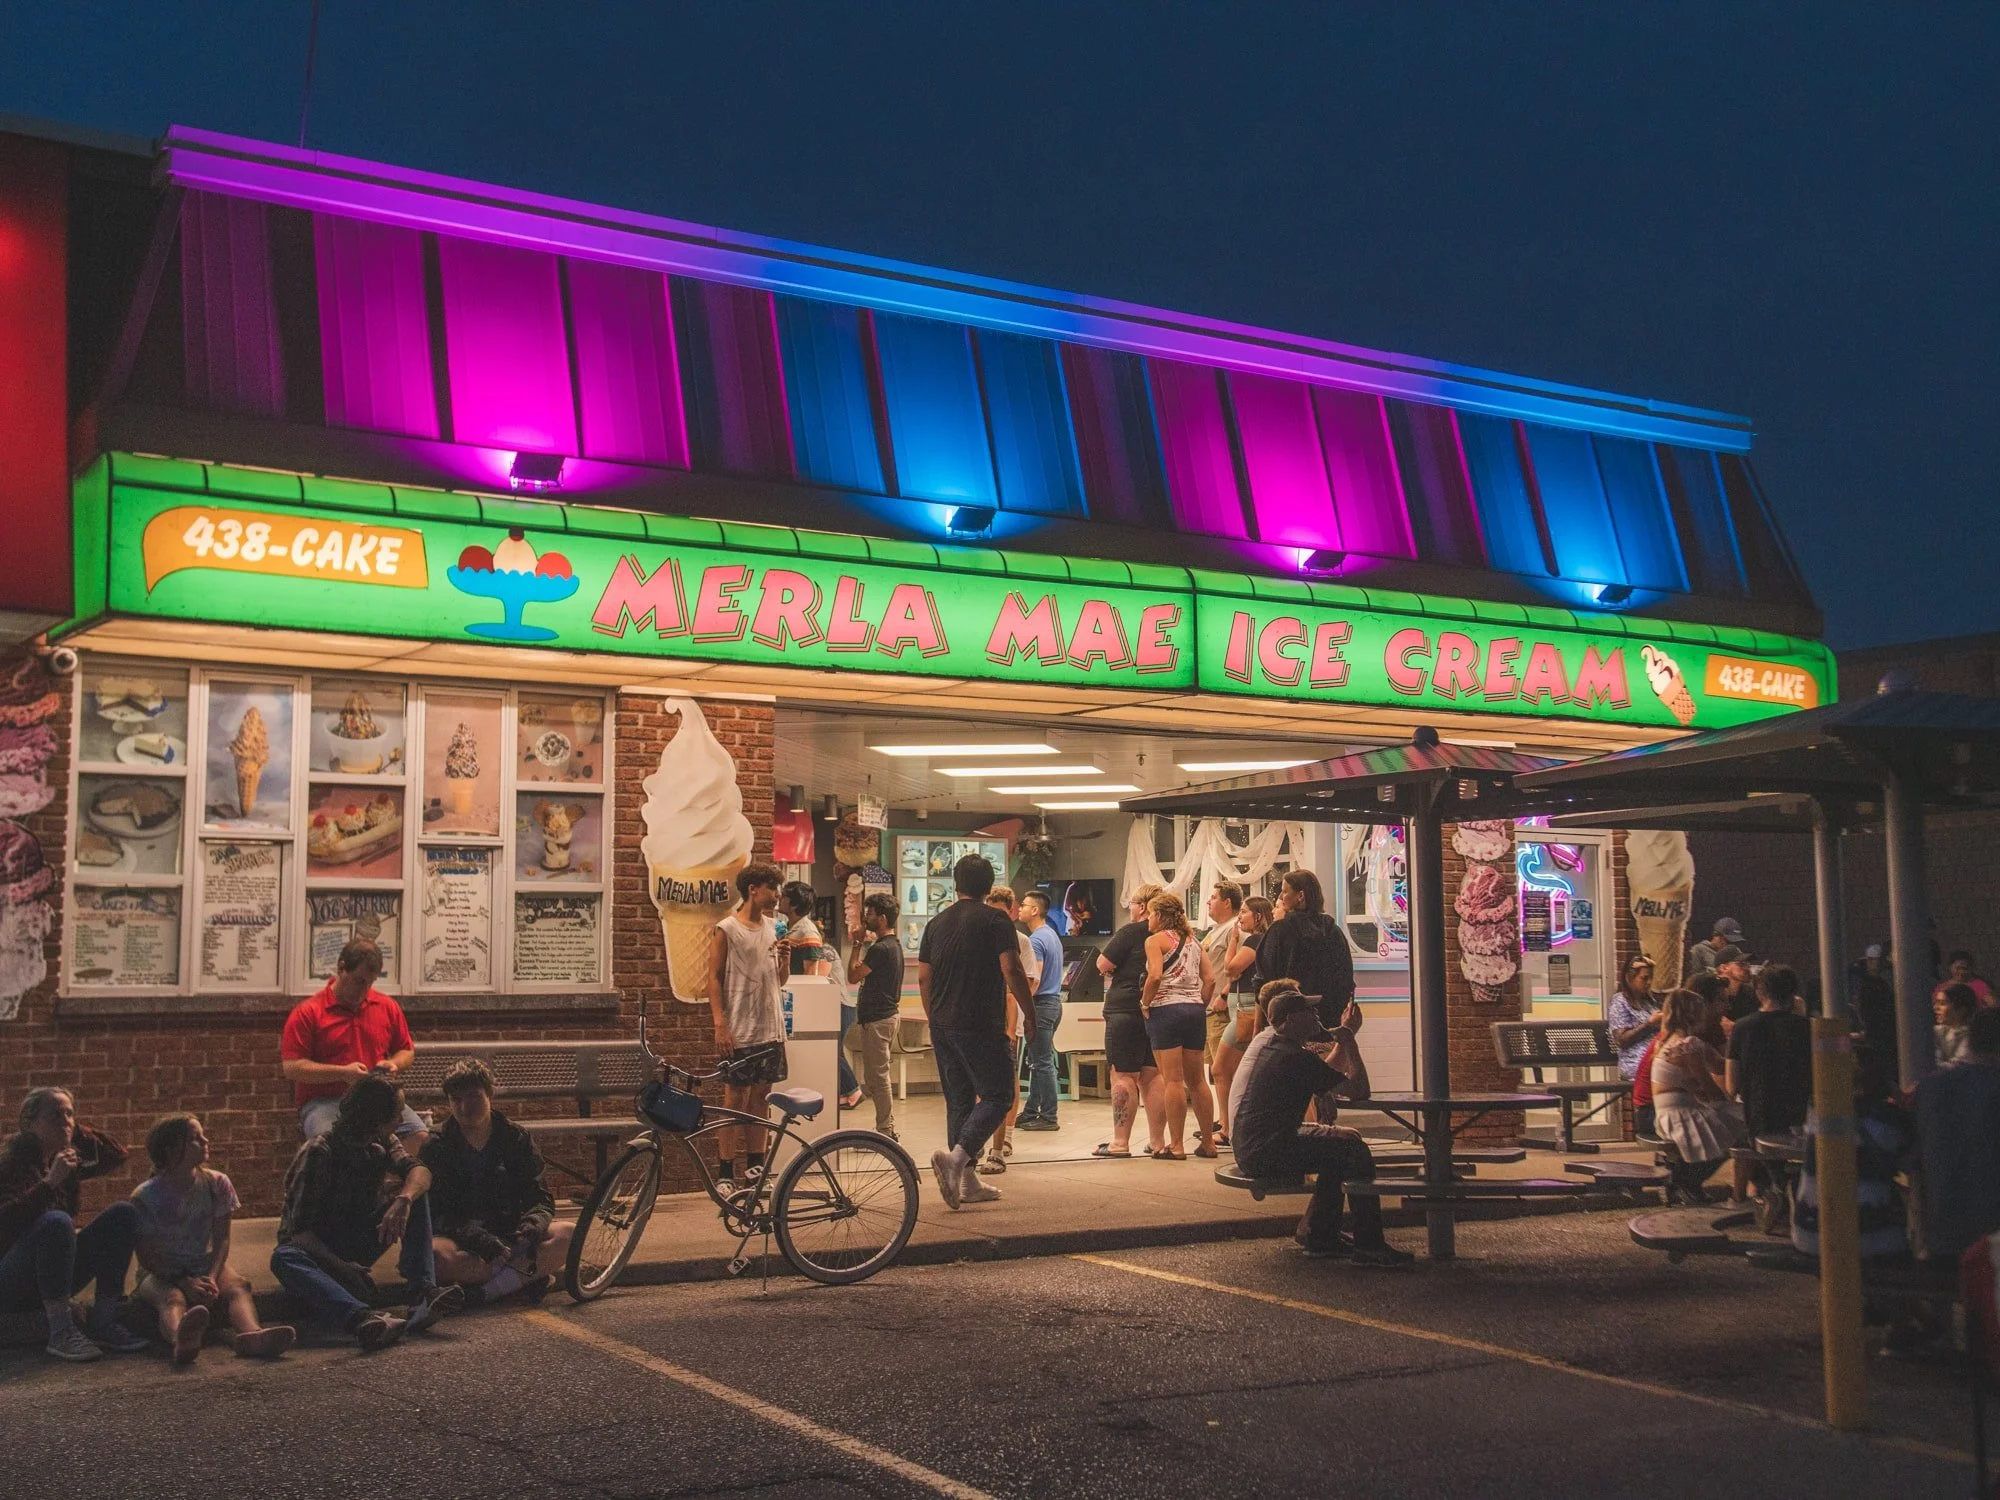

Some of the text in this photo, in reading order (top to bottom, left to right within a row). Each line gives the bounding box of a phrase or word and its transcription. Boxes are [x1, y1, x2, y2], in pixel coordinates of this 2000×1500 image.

[183, 515, 403, 576] 438-CAKE
[591, 554, 1632, 711] MERLA MAE ICE CREAM
[1717, 663, 1806, 700] 438-CAKE
